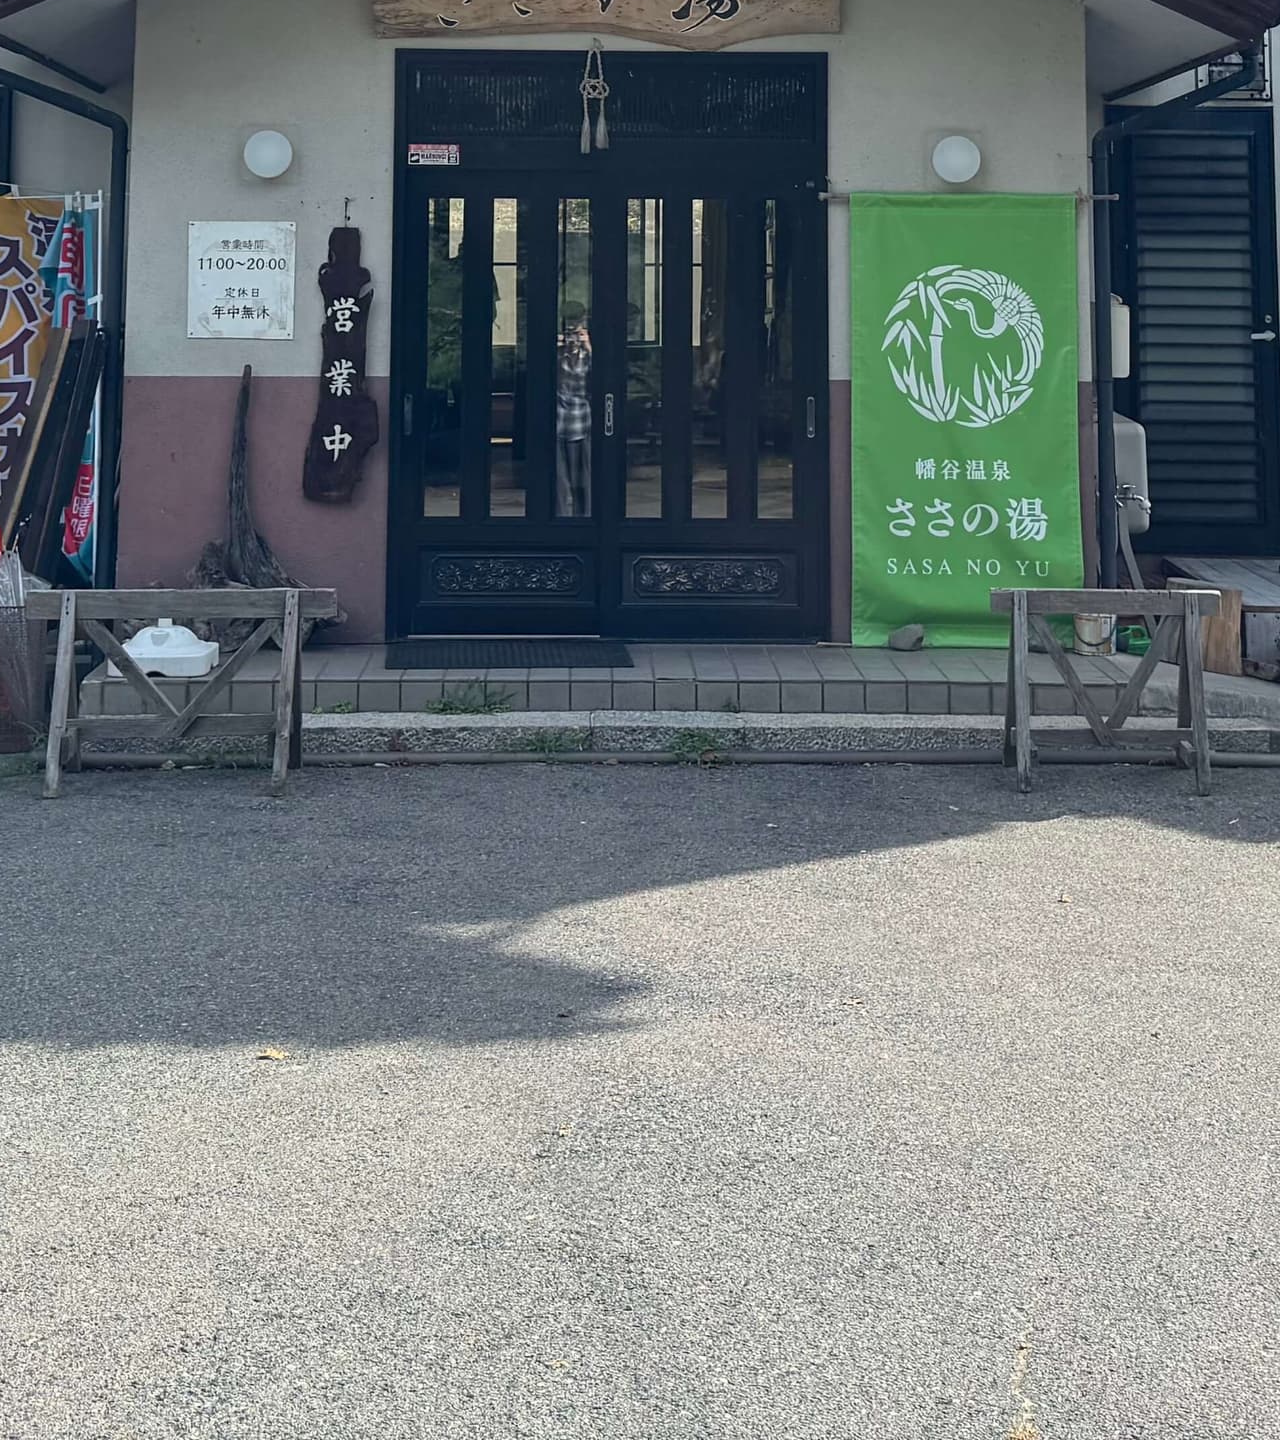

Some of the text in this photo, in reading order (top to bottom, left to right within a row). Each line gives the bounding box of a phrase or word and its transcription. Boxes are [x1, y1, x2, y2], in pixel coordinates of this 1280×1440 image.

[221, 240, 264, 249] 営業時間
[225, 287, 260, 298] 定休日
[212, 305, 270, 319] 年中無休
[322, 296, 360, 462] 営業中
[915, 458, 1011, 481] 幡谷温泉
[70, 475, 94, 545] 日曜限
[886, 498, 1048, 541] ささの湯
[887, 558, 1049, 577] SASA NO YU
